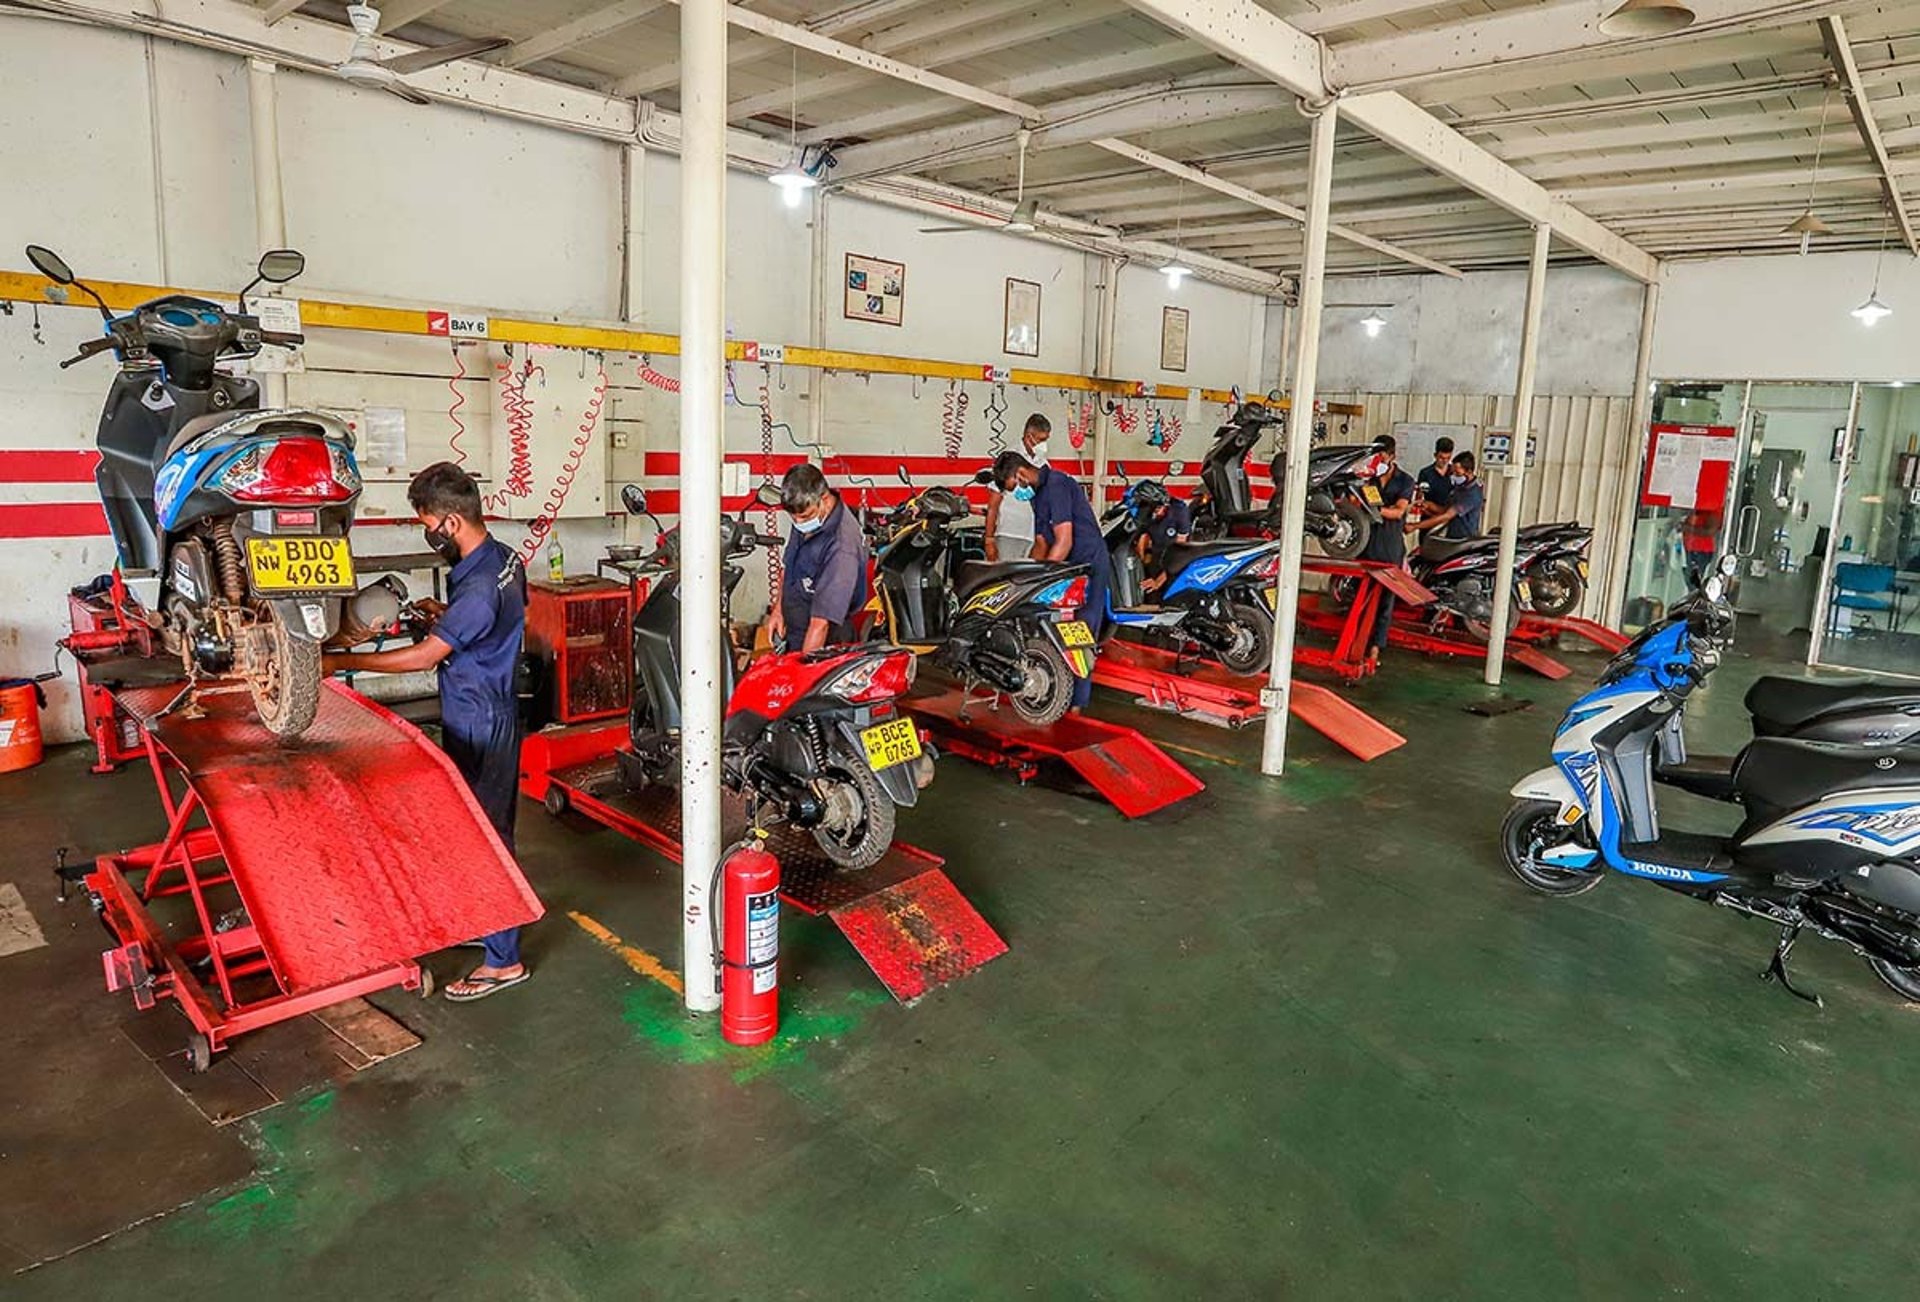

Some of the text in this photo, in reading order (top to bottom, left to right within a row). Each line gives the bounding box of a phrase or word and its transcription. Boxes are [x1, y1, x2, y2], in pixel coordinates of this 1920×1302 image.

[451, 319, 486, 333] BAY 6
[759, 347, 775, 357] BAY
[285, 541, 334, 561] BDO
[256, 555, 280, 570] NW
[286, 564, 340, 585] 4963
[880, 721, 909, 743] BCE
[1633, 861, 1694, 881] HONDA
